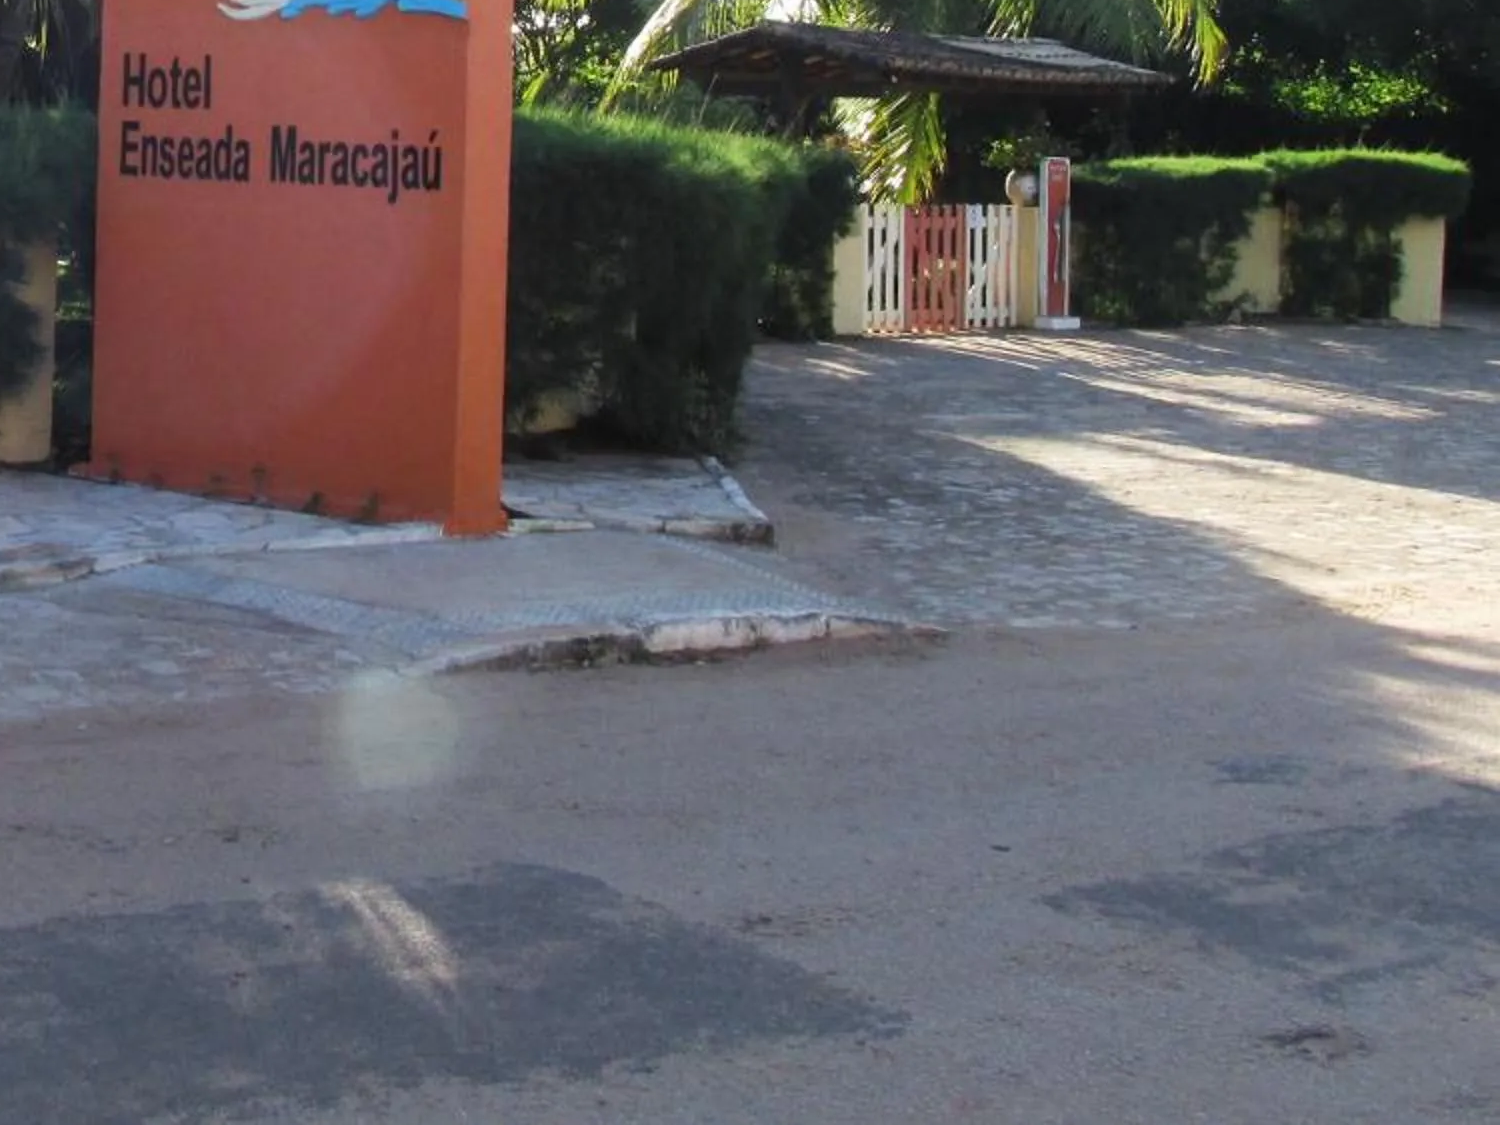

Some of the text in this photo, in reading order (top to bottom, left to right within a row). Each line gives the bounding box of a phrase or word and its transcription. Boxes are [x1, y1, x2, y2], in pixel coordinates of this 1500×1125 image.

[121, 51, 212, 110] Hotel
[119, 121, 443, 205] Enseada Maracajaú
